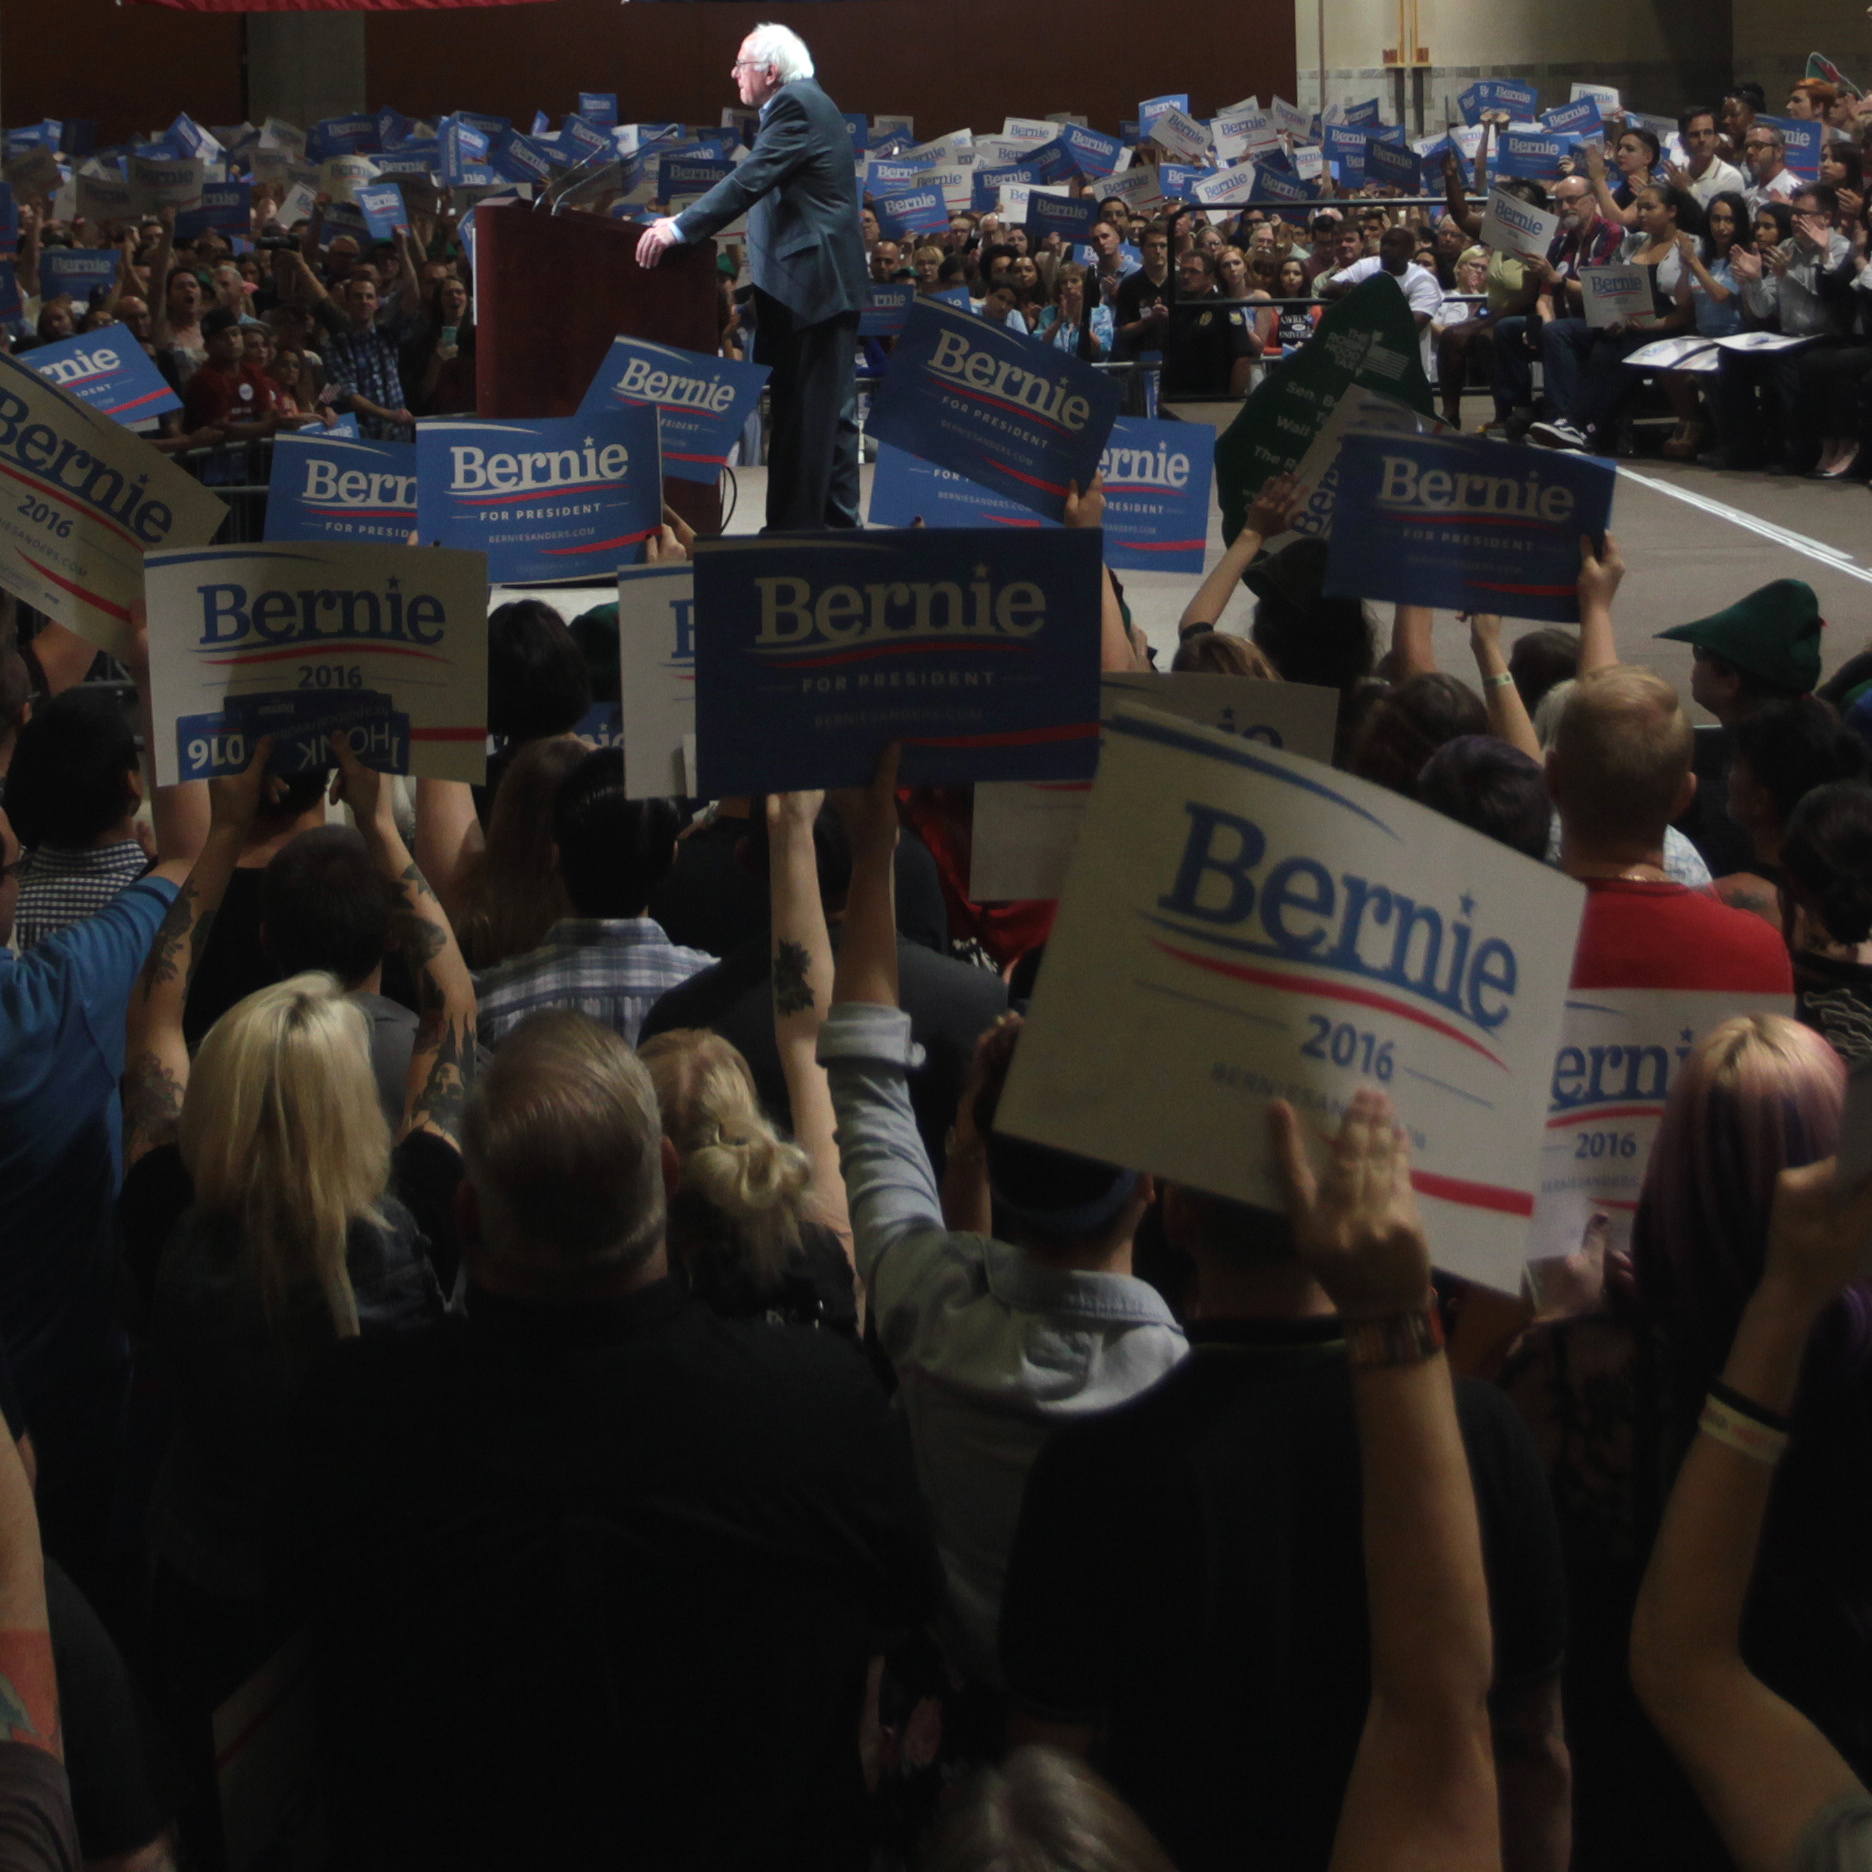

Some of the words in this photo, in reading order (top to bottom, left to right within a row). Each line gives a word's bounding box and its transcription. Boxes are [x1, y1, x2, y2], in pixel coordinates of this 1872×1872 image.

[1220, 115, 1268, 137] Bernie
[1548, 104, 1591, 127] Bernie
[1009, 124, 1050, 139] Bernie
[1168, 113, 1205, 146] Bernie
[1071, 130, 1114, 156] Bernie
[1508, 135, 1560, 156] Bernie
[1373, 145, 1414, 170] Bernie
[135, 164, 194, 184] Bernie
[983, 169, 1032, 188] Bernie
[1103, 173, 1149, 194] Bernie
[1203, 172, 1248, 200] Bernie
[1259, 171, 1309, 202] Bernie
[884, 191, 937, 215] Bernie
[1036, 198, 1089, 219] Bernie
[1494, 197, 1545, 237] Bernie
[51, 256, 112, 274] Bernie
[1591, 275, 1644, 296] Bernie
[616, 357, 737, 414] Bernie
[928, 329, 1091, 432] Bernie
[941, 395, 969, 415] FOR
[972, 407, 1050, 451] PRESIDENT
[450, 435, 629, 491] Bernie
[1097, 440, 1191, 488] ernie
[1378, 455, 1575, 523] Bernie
[17, 494, 75, 539] 2016
[479, 509, 510, 522] FOR
[515, 502, 602, 520] PRESIDENT
[1104, 501, 1165, 515] RESIDENT
[325, 521, 354, 534] FOR
[488, 527, 596, 545] BERNIESANDERS.COM
[1403, 528, 1434, 542] FOR
[1440, 532, 1534, 552] PRESIDENT
[197, 574, 447, 646] Bernie
[753, 560, 1048, 645] Bernie
[297, 665, 364, 689] 2016
[802, 675, 848, 694] FOR
[858, 669, 997, 691] PRESIDENT
[1157, 800, 1517, 1030] Bernie
[1300, 1014, 1396, 1083] 2016
[1574, 1131, 1637, 1159] 2016
